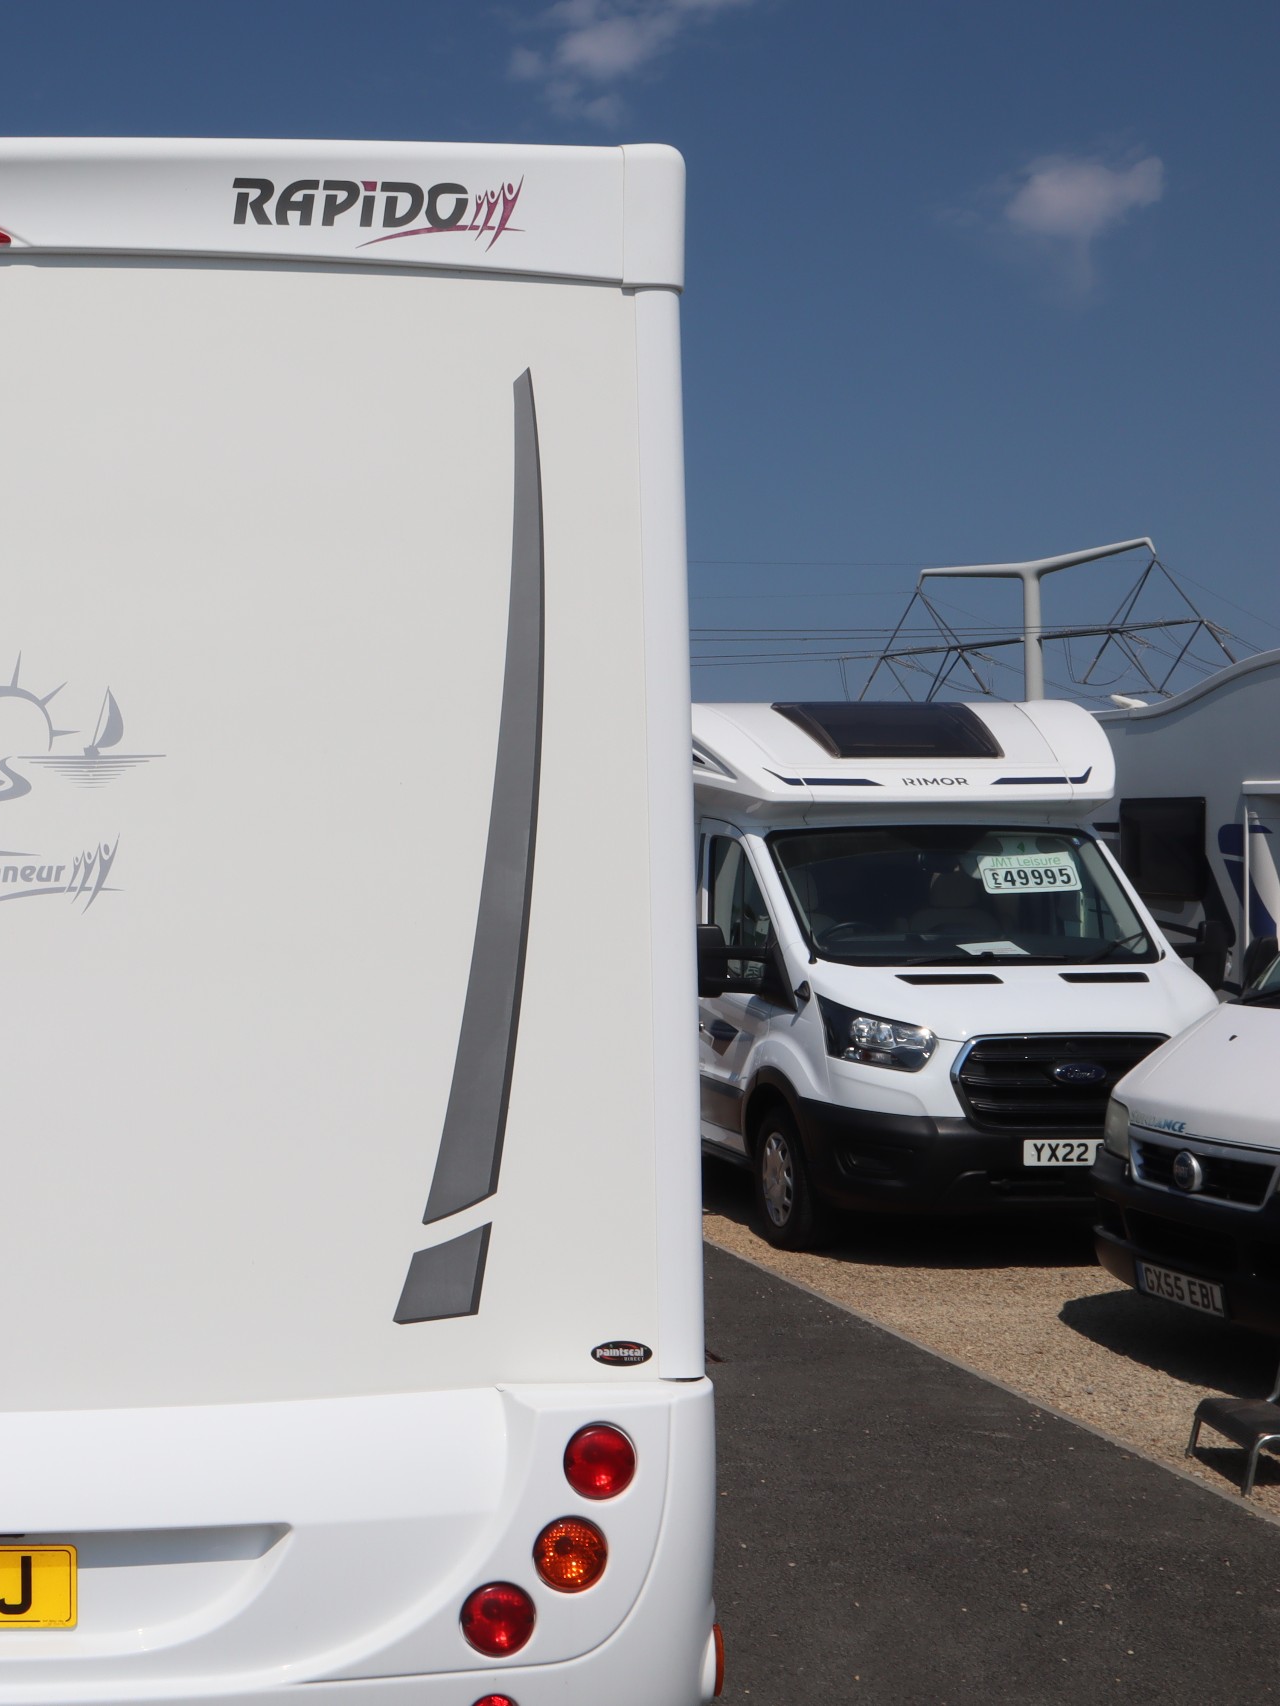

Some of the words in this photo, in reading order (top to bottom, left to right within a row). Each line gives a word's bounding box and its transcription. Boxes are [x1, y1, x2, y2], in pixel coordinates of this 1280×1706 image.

[901, 777, 970, 786] RIMOR
[990, 857, 1014, 868] JMT
[1017, 855, 1062, 867] Leisure
[991, 868, 1072, 888] £49995
[1033, 1143, 1089, 1163] YX22
[1144, 1267, 1185, 1301] GX55
[1187, 1280, 1223, 1313] EBL
